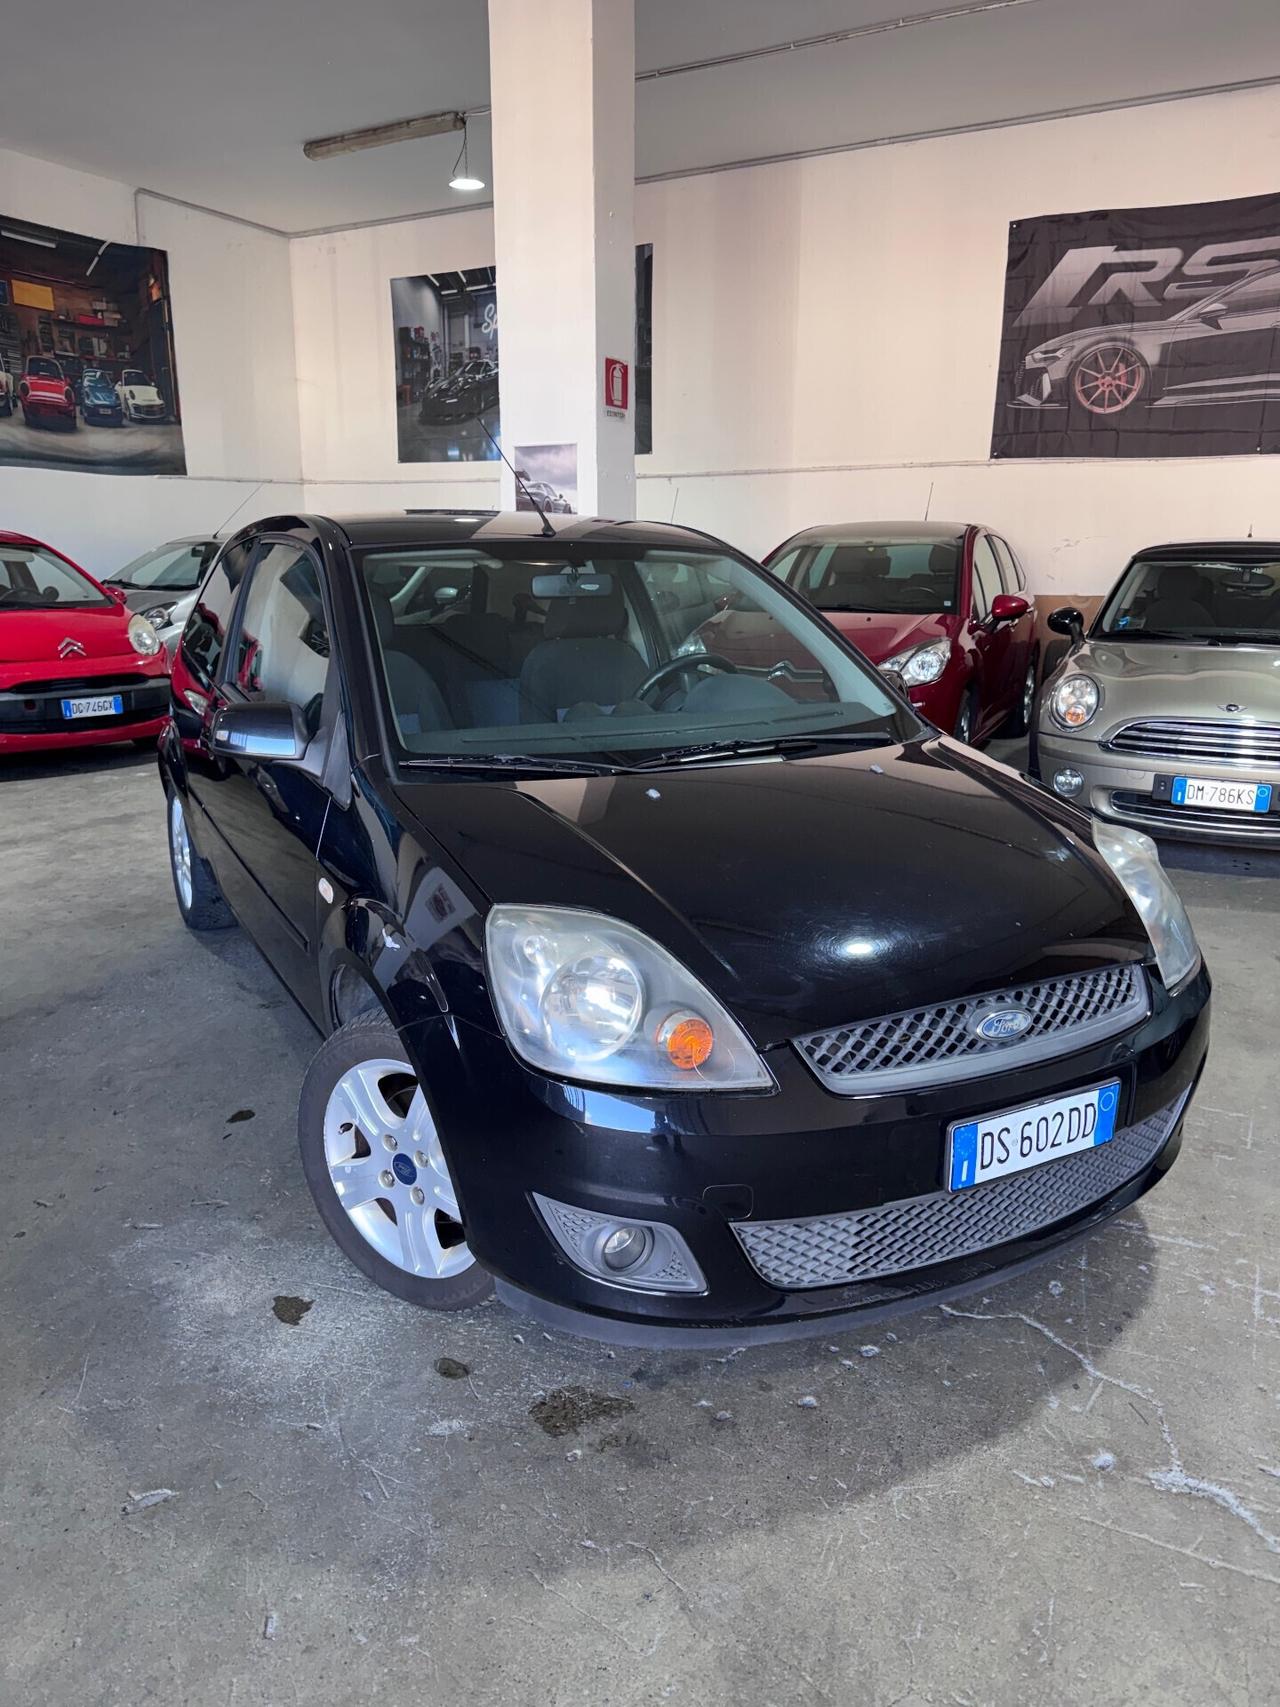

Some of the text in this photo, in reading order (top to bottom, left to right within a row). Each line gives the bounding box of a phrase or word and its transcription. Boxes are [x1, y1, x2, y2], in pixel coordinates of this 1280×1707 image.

[1012, 235, 1280, 328] RS
[1187, 784, 1255, 805] DM 786KS
[980, 1102, 1097, 1170] DS 602DD
